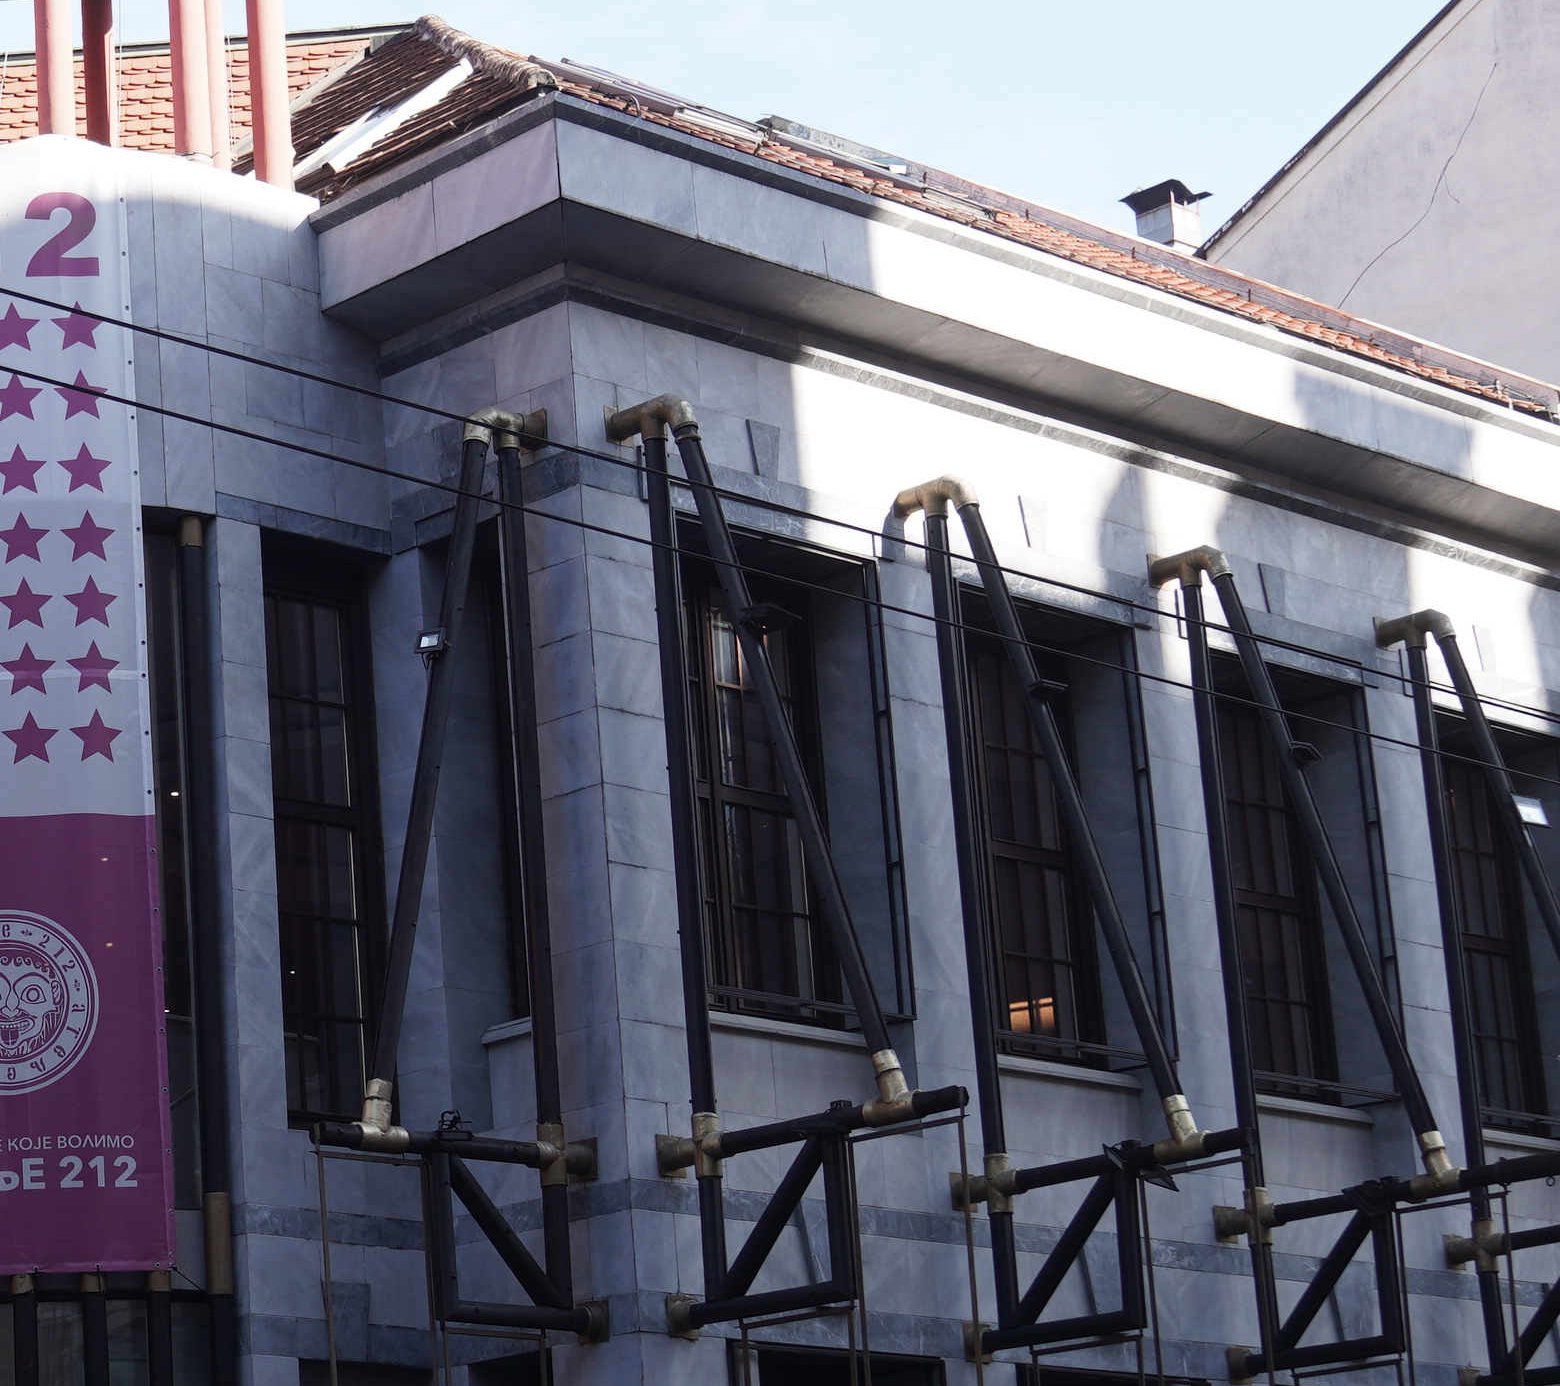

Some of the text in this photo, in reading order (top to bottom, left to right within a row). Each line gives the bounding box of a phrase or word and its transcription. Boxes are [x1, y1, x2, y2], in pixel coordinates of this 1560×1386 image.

[37, 933, 77, 973] 212
[7, 1136, 52, 1152] КОЈЕ
[57, 1134, 135, 1150] ВОЛИМО
[58, 1154, 139, 1189] 212
